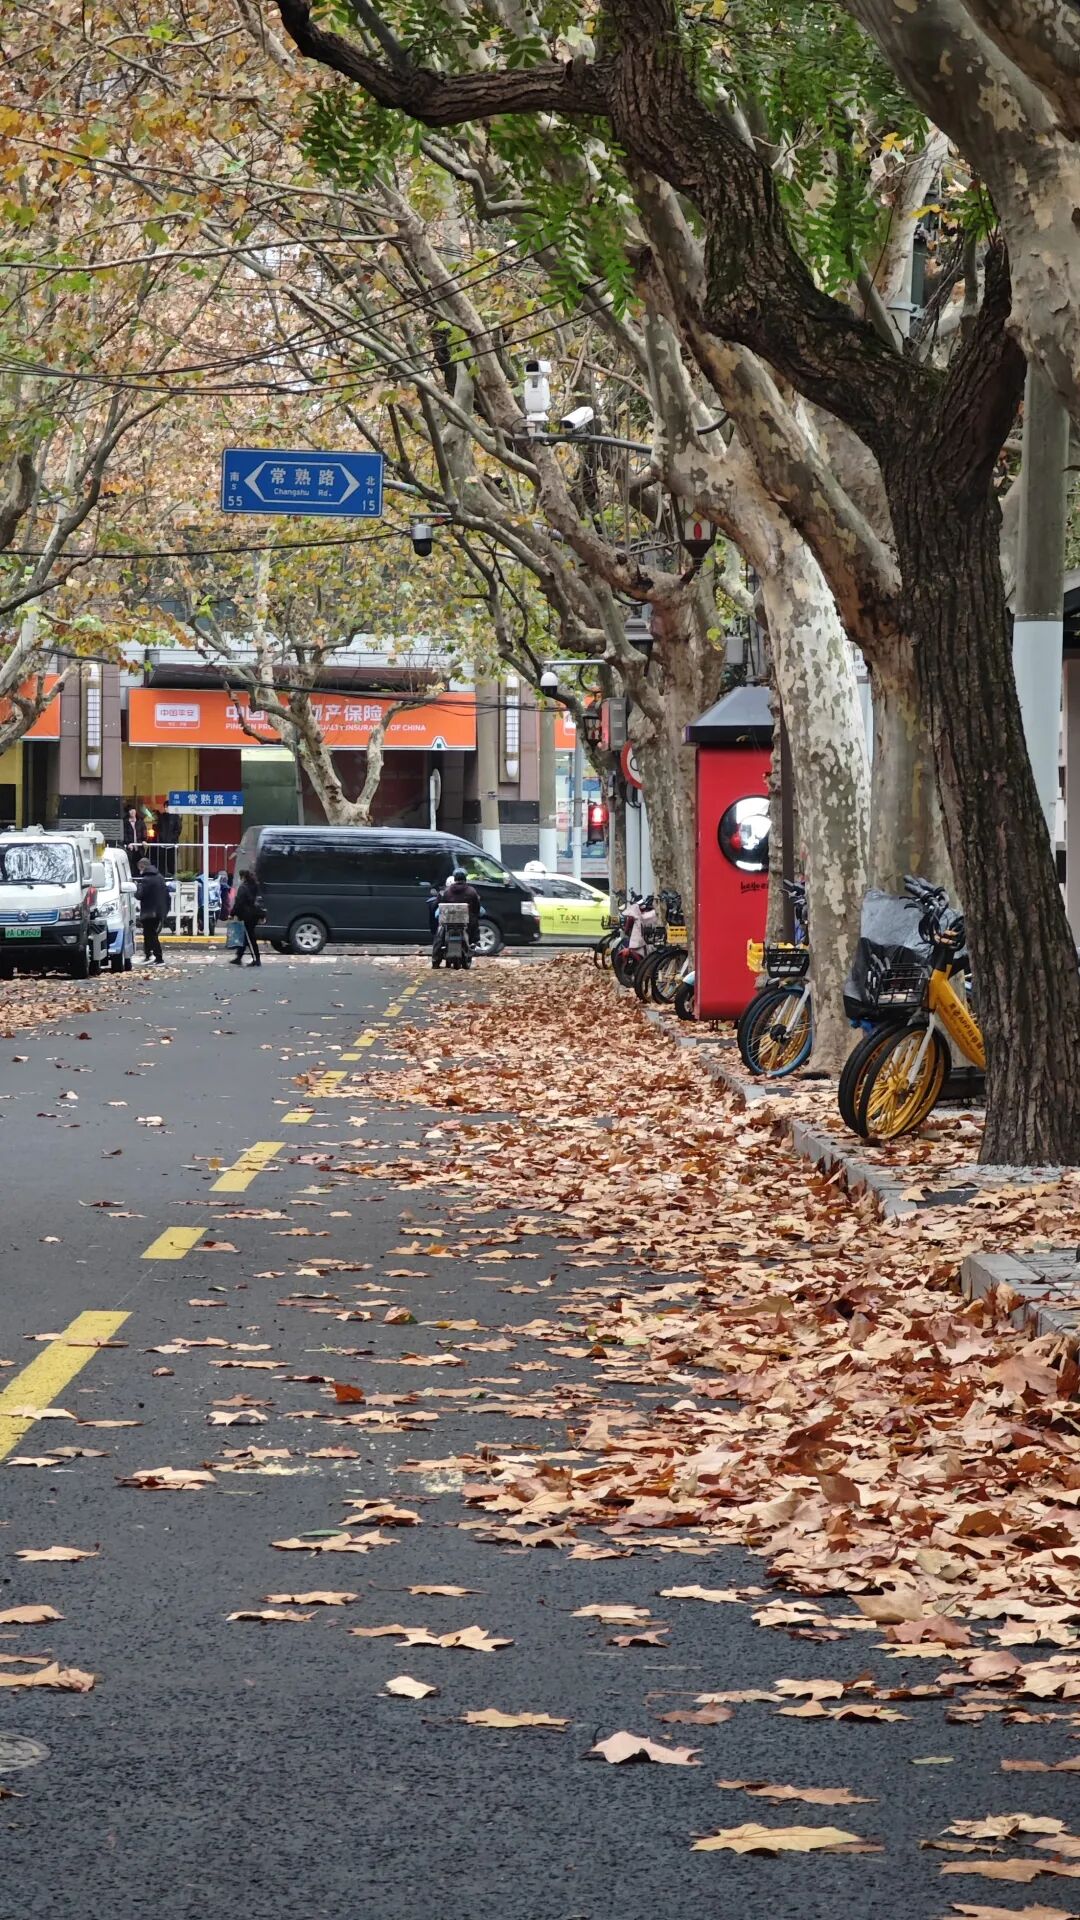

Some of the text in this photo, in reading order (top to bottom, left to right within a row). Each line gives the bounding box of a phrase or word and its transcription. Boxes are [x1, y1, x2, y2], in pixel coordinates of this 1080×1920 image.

[230, 467, 375, 487] 南 常熟路 北
[231, 483, 237, 491] S
[273, 487, 310, 497] Changshu
[318, 489, 333, 497] Rd.
[228, 495, 375, 511] 55 15
[187, 793, 225, 806] 常熟路
